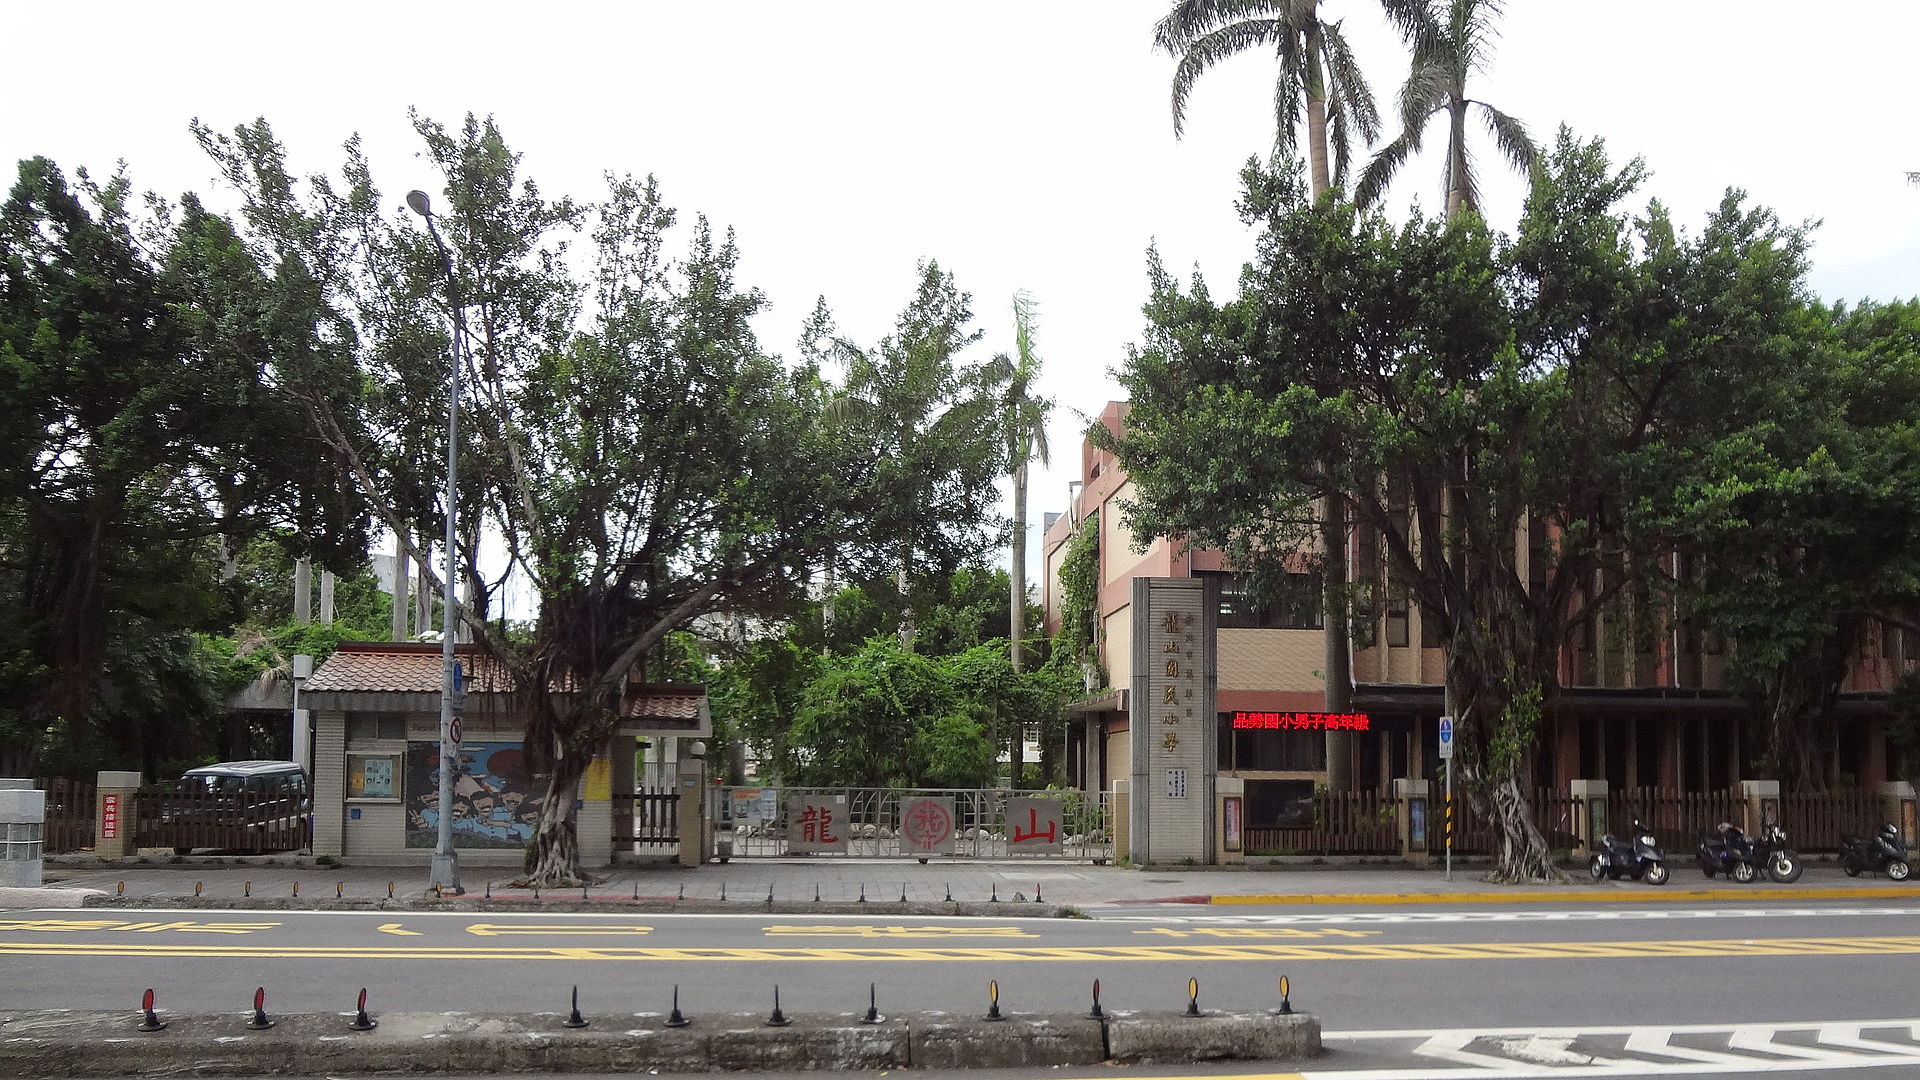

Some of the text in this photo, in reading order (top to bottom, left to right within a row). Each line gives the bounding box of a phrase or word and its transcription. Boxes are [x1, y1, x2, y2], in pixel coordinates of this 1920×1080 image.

[1233, 712, 1369, 731] 品勢國小男子高年級
[104, 796, 116, 838] 家長接送區
[795, 805, 839, 844] 龍
[1013, 808, 1056, 844] 山
